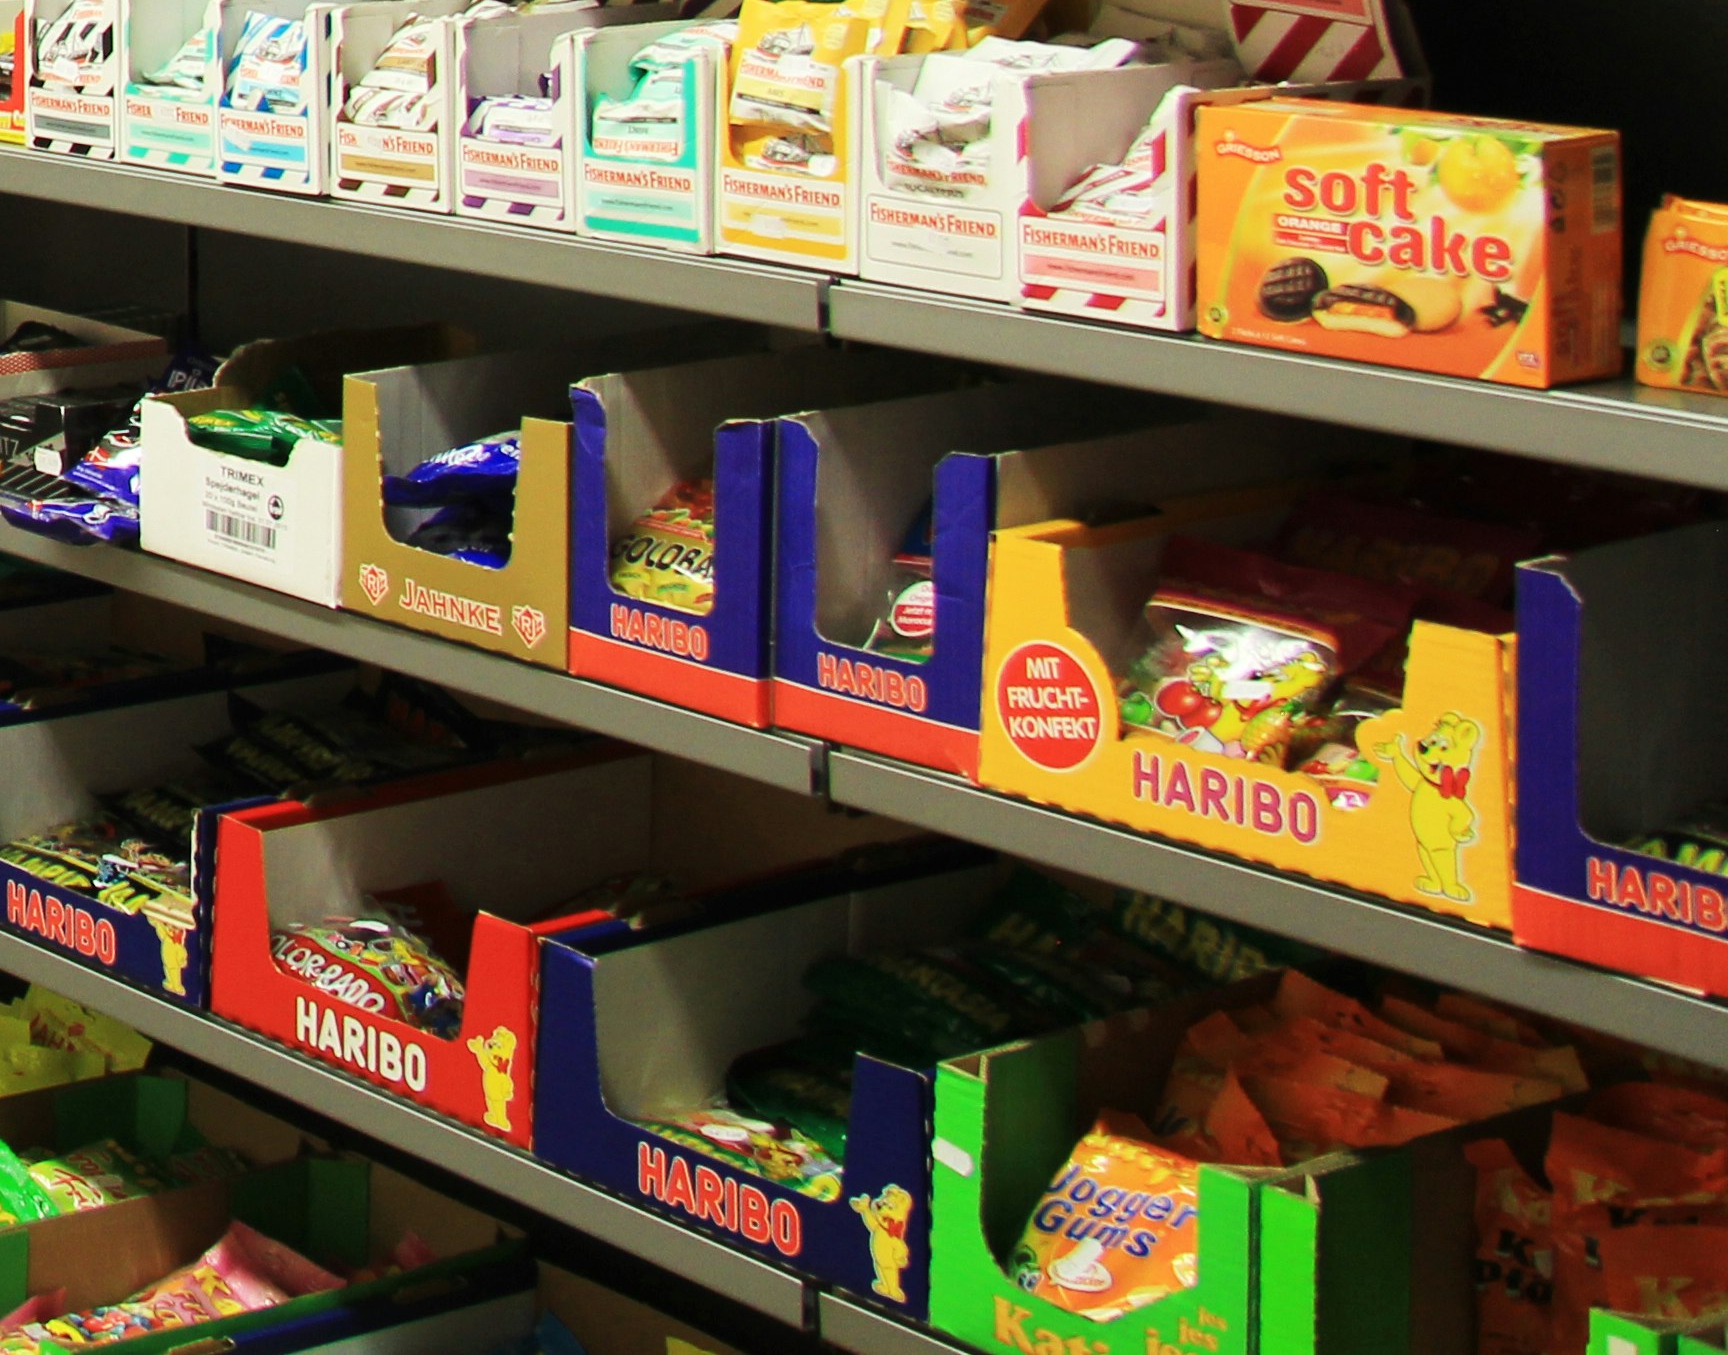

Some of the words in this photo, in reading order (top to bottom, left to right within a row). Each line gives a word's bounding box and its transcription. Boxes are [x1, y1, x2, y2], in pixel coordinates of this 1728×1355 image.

[31, 91, 76, 113] FISHERMAN'S
[77, 94, 109, 117] FRIEND
[176, 106, 208, 125] FRIEND
[271, 120, 304, 138] FRIEND
[394, 136, 434, 155] FRIEND
[463, 143, 520, 170] FISHERMAN'S
[520, 149, 559, 172] FRIEND
[1216, 143, 1280, 162] GRIESSON
[584, 163, 646, 188] FISHERMAN'S
[650, 169, 692, 191] FRIEND
[724, 173, 793, 203] FISHERMAN'S
[794, 181, 840, 208] FRIEND
[1283, 163, 1417, 222] soft
[871, 202, 945, 232] FISHERMAN'S
[946, 209, 996, 237] FRIEND
[1277, 215, 1341, 233] ORANGE
[1023, 225, 1106, 253] FISHERMAN'S
[1108, 232, 1160, 259] FRIEND
[1347, 216, 1512, 279] cake
[1665, 239, 1728, 261] GRIESSO
[220, 465, 264, 488] TRIMEX
[399, 579, 502, 637] JAHNKE
[610, 604, 710, 661] HARIBO
[817, 652, 927, 712] HARIBO
[1026, 657, 1059, 679] MIT
[1007, 688, 1089, 710] FRUCHT-
[1009, 715, 1097, 740] KONFEKT
[1132, 751, 1318, 843] HARIBO
[1587, 857, 1728, 934] HARIB
[6, 879, 117, 965] HARIBO
[296, 996, 427, 1092] HARIBO
[638, 1141, 801, 1257] HARIBO
[1047, 1163, 1199, 1229] Jogger
[1031, 1196, 1156, 1256] Gums
